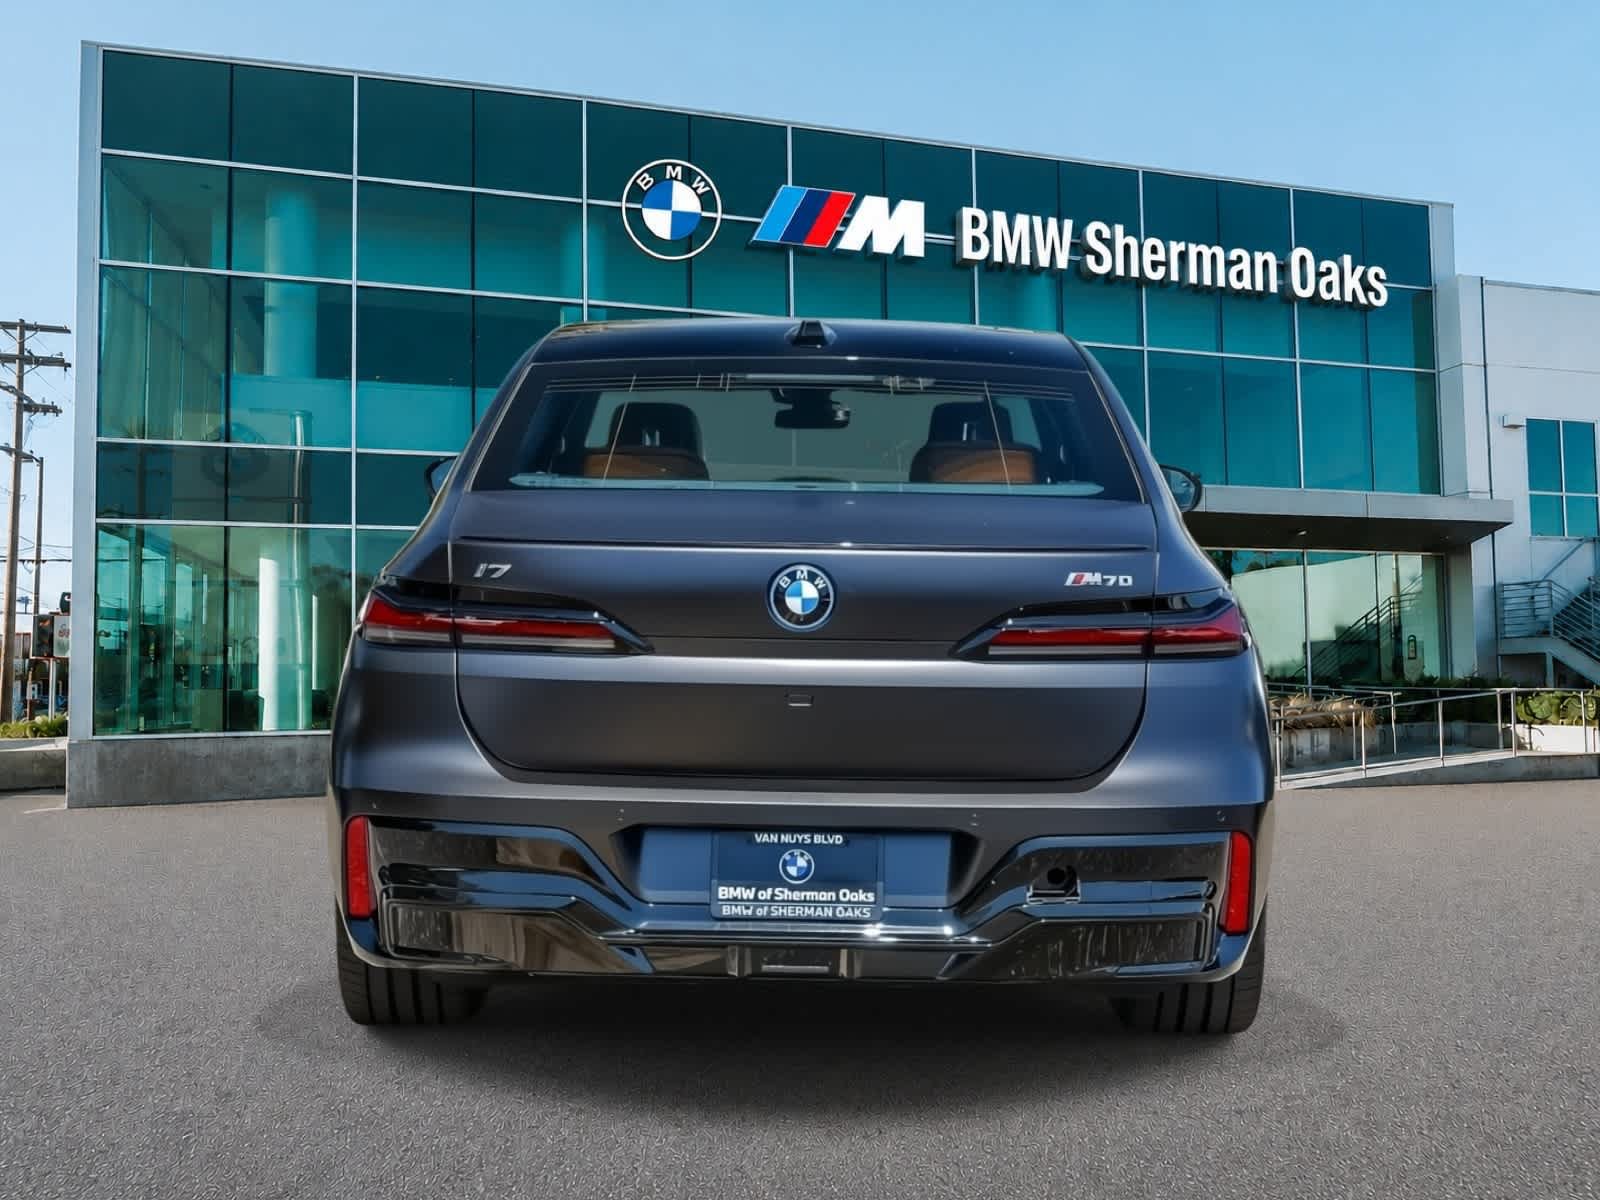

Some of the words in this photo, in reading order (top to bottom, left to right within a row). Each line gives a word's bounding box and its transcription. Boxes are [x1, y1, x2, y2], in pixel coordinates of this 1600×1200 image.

[636, 165, 711, 196] BMW
[960, 206, 1073, 270] BMW
[1084, 220, 1278, 293] Sherman
[1289, 247, 1388, 308] Oaks
[779, 569, 826, 589] BMW
[755, 833, 778, 843] VAN
[780, 833, 811, 844] NUYS
[814, 834, 843, 844] BLVD
[718, 886, 756, 900] BMW
[758, 888, 772, 900] of
[774, 888, 835, 901] Sherman
[838, 889, 875, 902] Oaks
[722, 905, 752, 916] BMW
[756, 905, 768, 916] of
[770, 906, 832, 917] SHERMAN
[836, 907, 871, 918] OAKS
